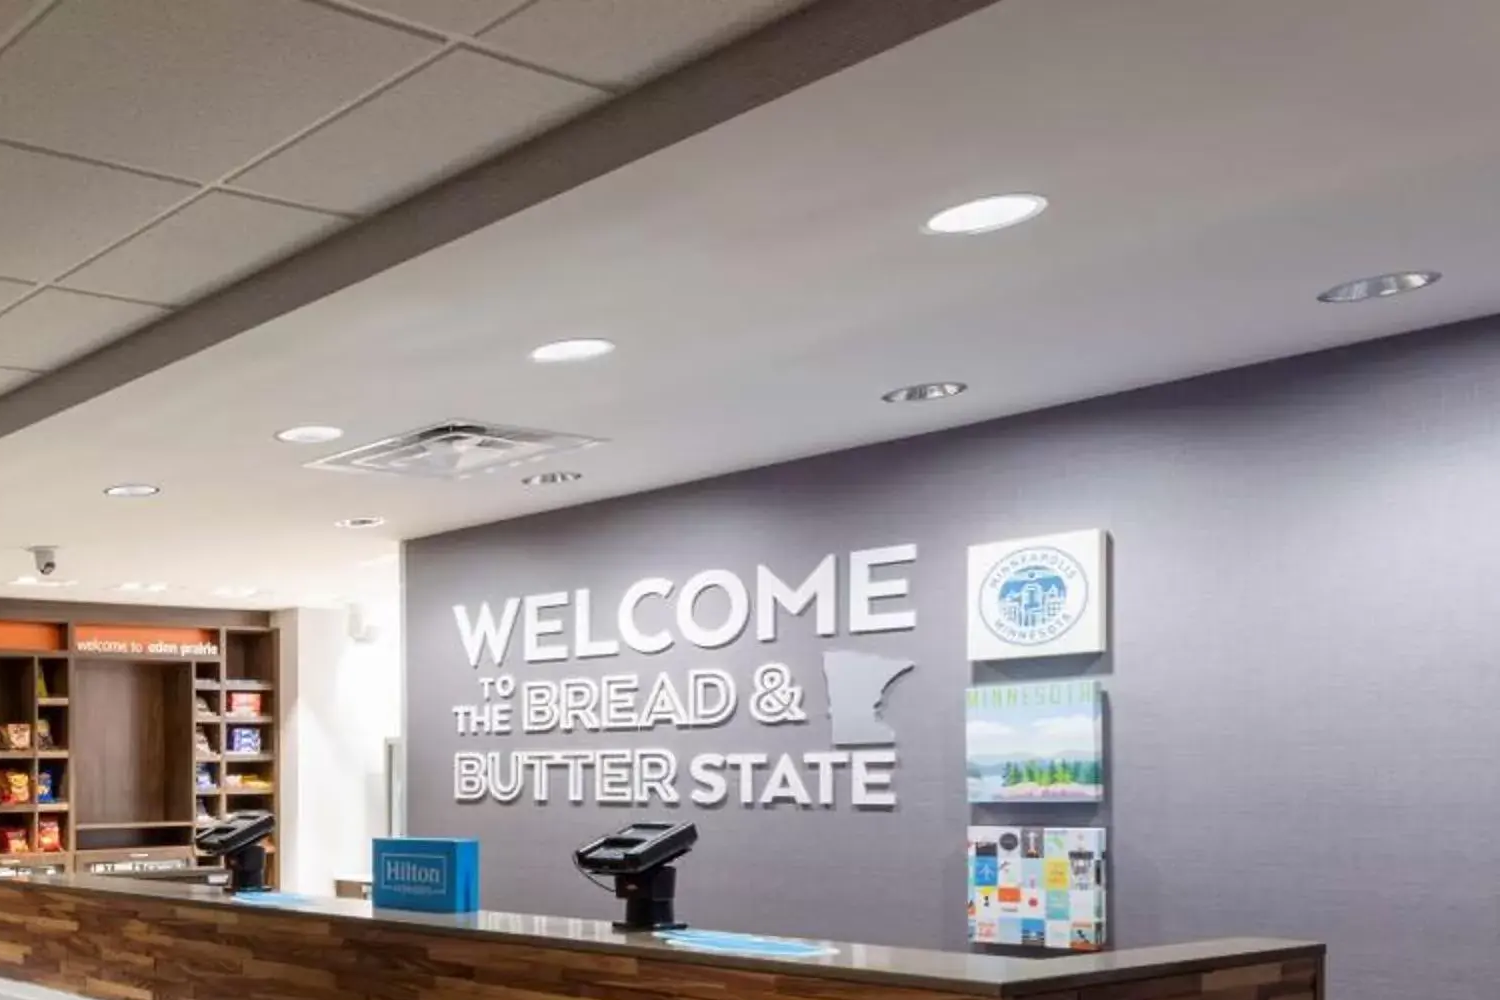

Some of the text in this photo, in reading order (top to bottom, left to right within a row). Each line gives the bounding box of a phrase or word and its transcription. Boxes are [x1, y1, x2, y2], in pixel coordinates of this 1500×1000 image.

[453, 543, 918, 669] WELCOME
[994, 611, 1072, 641] MINNESOTA
[76, 637, 218, 657] welcome to eden prairie
[452, 662, 807, 734] THE BREAD &
[480, 675, 515, 699] TO
[966, 682, 1095, 708] MINNESOTA
[453, 749, 897, 808] BUTTER STATE
[386, 859, 441, 884] Hilton
